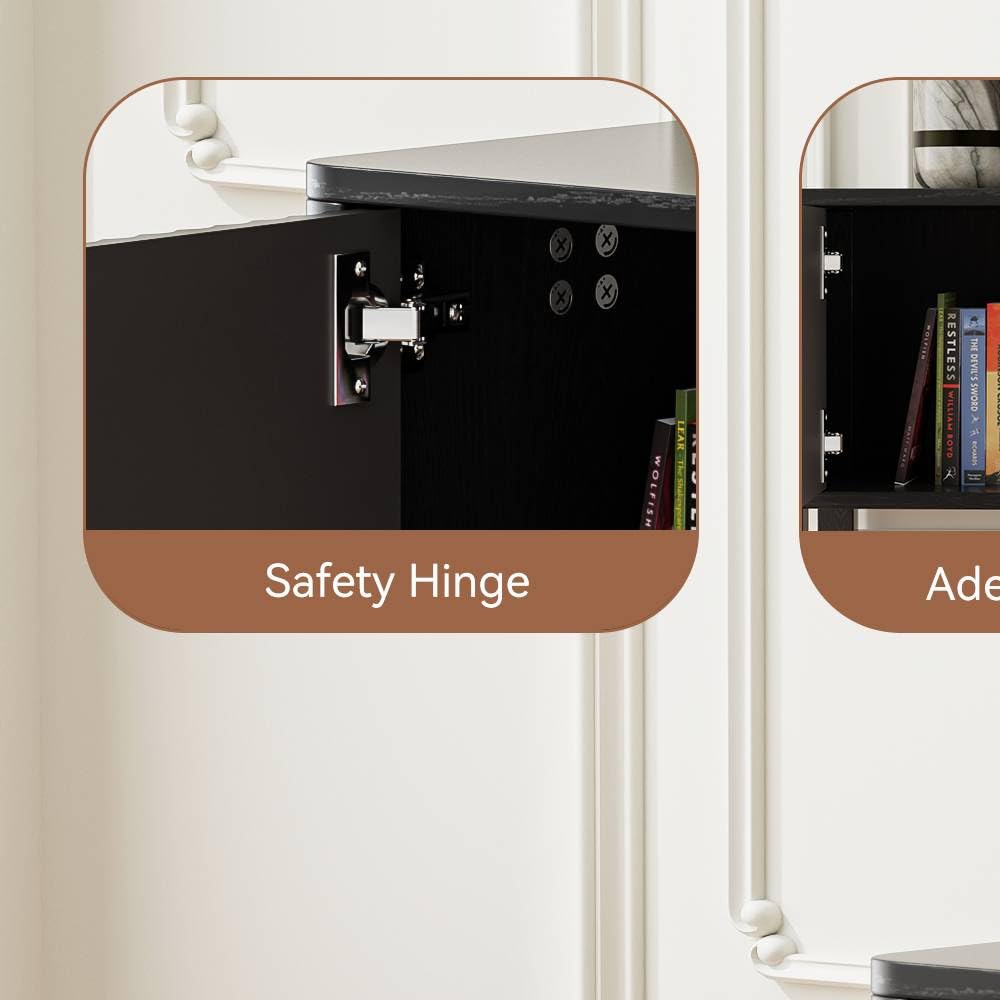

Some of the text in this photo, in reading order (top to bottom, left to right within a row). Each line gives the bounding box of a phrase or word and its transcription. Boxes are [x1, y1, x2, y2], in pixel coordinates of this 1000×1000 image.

[946, 313, 956, 381] RESTLESS
[970, 338, 978, 412] THE DEVIL'S SWORD
[677, 420, 685, 450] LEAR
[946, 433, 954, 458] BOYD
[644, 455, 662, 528] WOLFISH
